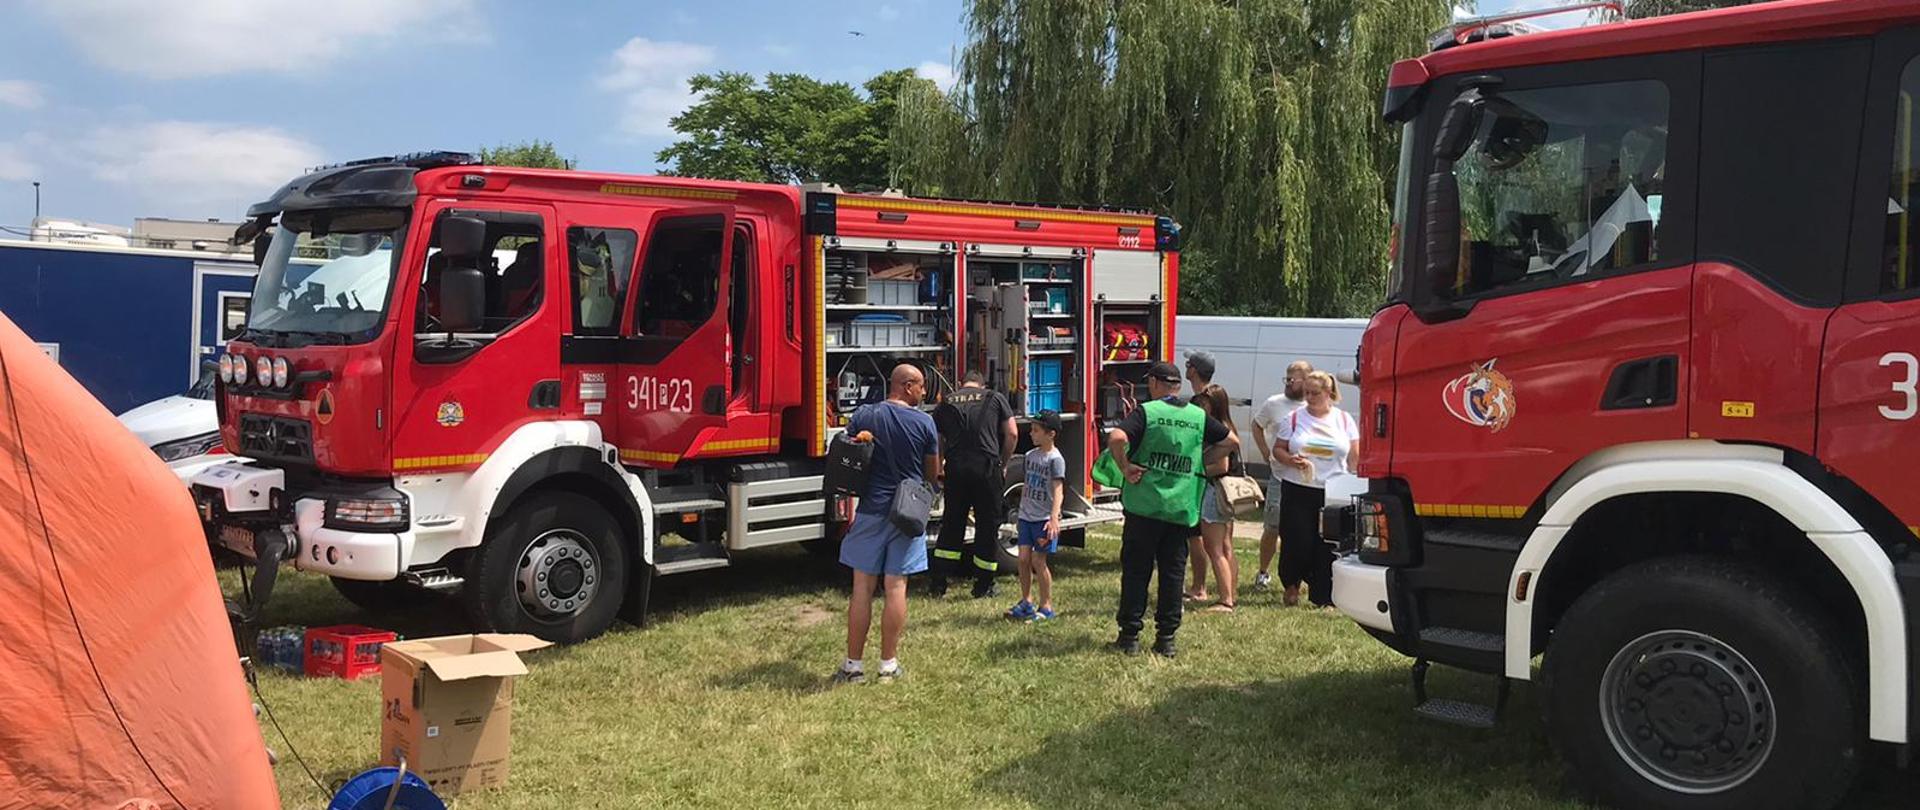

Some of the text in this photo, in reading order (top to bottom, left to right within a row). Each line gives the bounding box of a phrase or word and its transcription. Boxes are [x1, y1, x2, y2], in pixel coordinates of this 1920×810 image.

[1126, 236, 1140, 248] 112
[627, 376, 657, 411] 341
[670, 378, 692, 413] 23
[1878, 352, 1919, 420] 3
